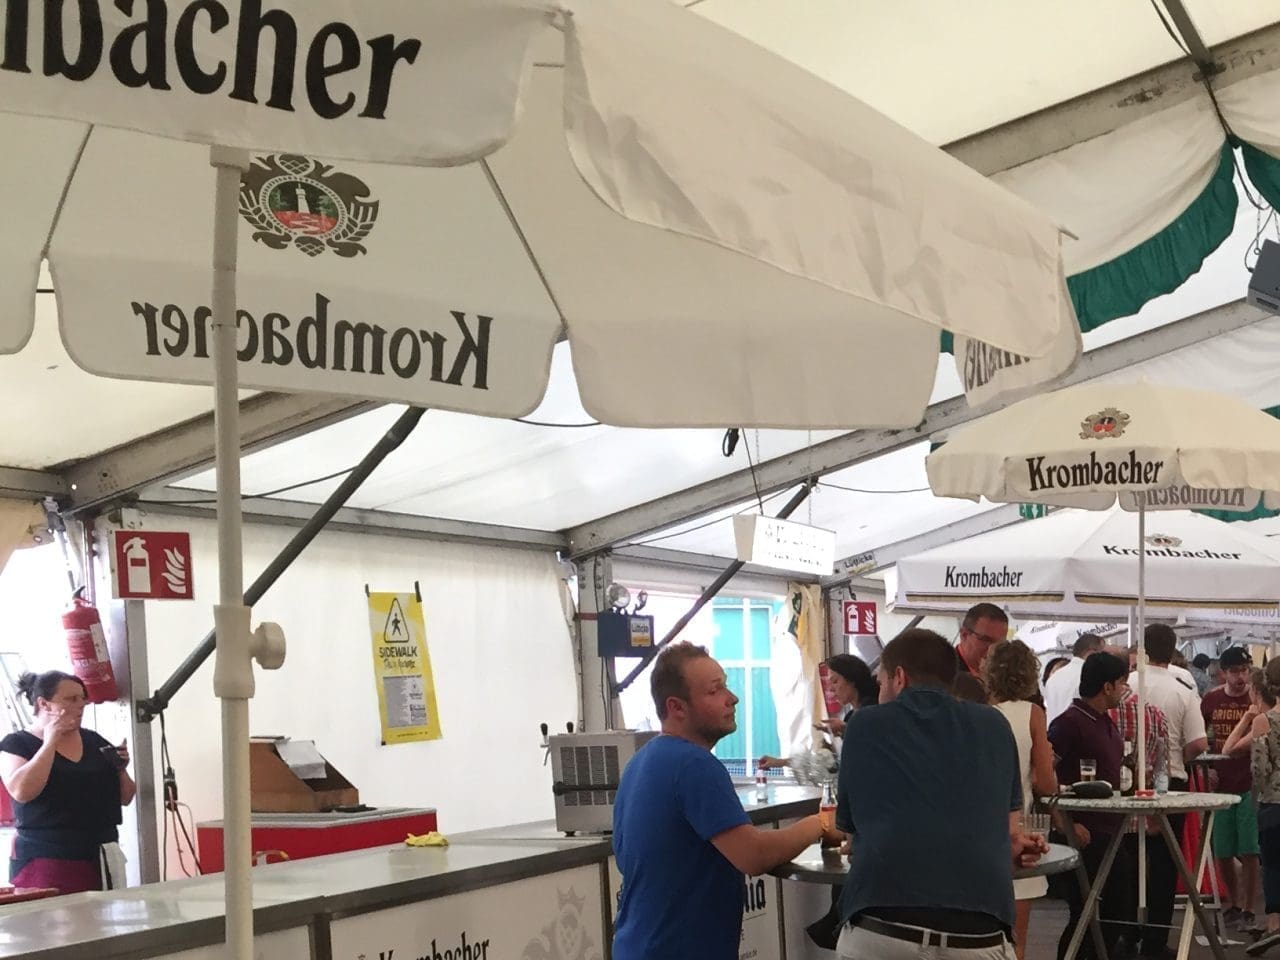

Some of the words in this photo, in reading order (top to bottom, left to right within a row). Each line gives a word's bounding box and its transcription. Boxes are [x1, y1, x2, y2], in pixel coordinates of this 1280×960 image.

[1026, 450, 1164, 491] Krombacher
[945, 565, 1023, 588] Krombacher
[379, 646, 418, 659] SIDEWALK
